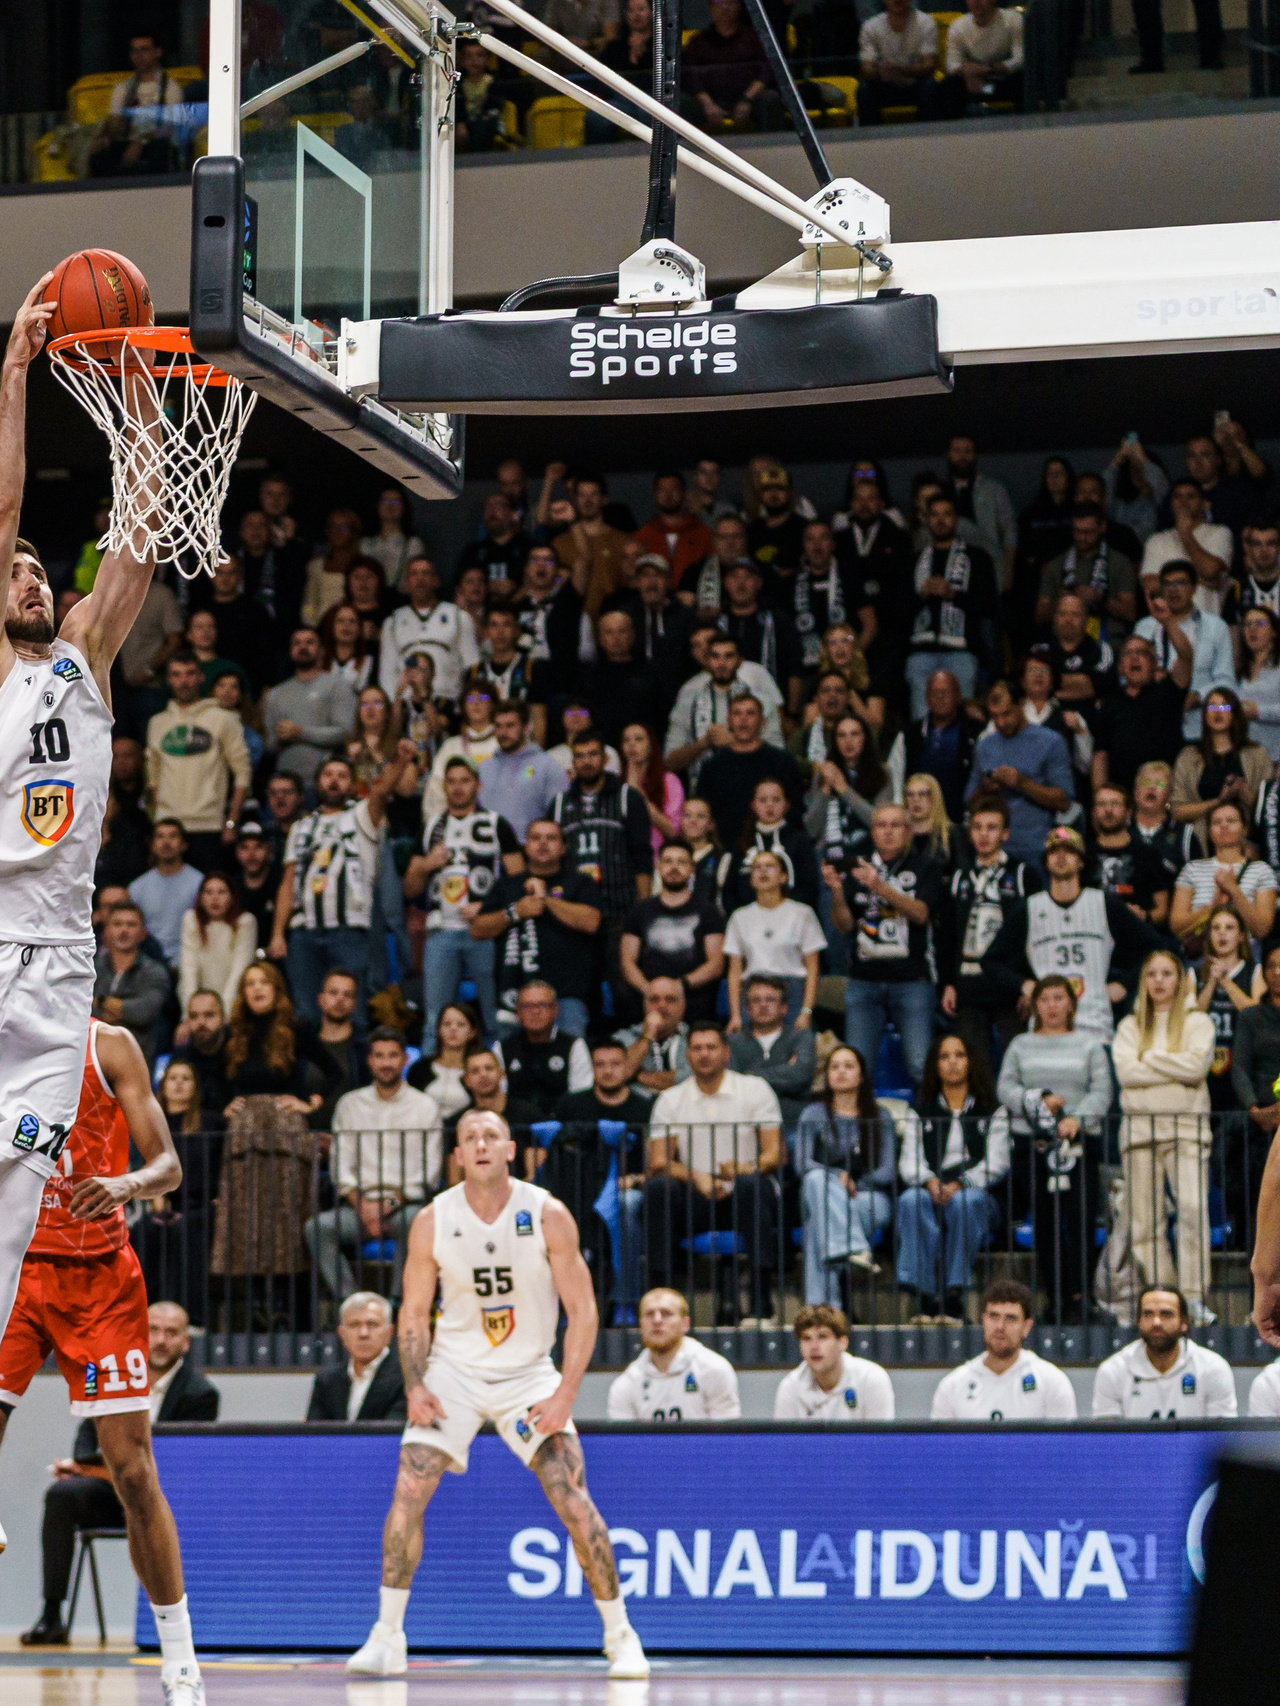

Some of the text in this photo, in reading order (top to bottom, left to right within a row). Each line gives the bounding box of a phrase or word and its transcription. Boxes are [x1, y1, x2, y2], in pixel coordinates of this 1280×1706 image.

[102, 267, 130, 328] PALDING
[570, 320, 737, 350] Schelde
[569, 348, 738, 385] Sports
[29, 717, 71, 764] 10
[33, 795, 64, 818] BT
[1056, 944, 1085, 967] 35
[472, 1266, 514, 1297] 55
[487, 1315, 509, 1330] BT
[99, 1348, 149, 1393] 19
[507, 1527, 1129, 1600] SIGNAL IDUNA
